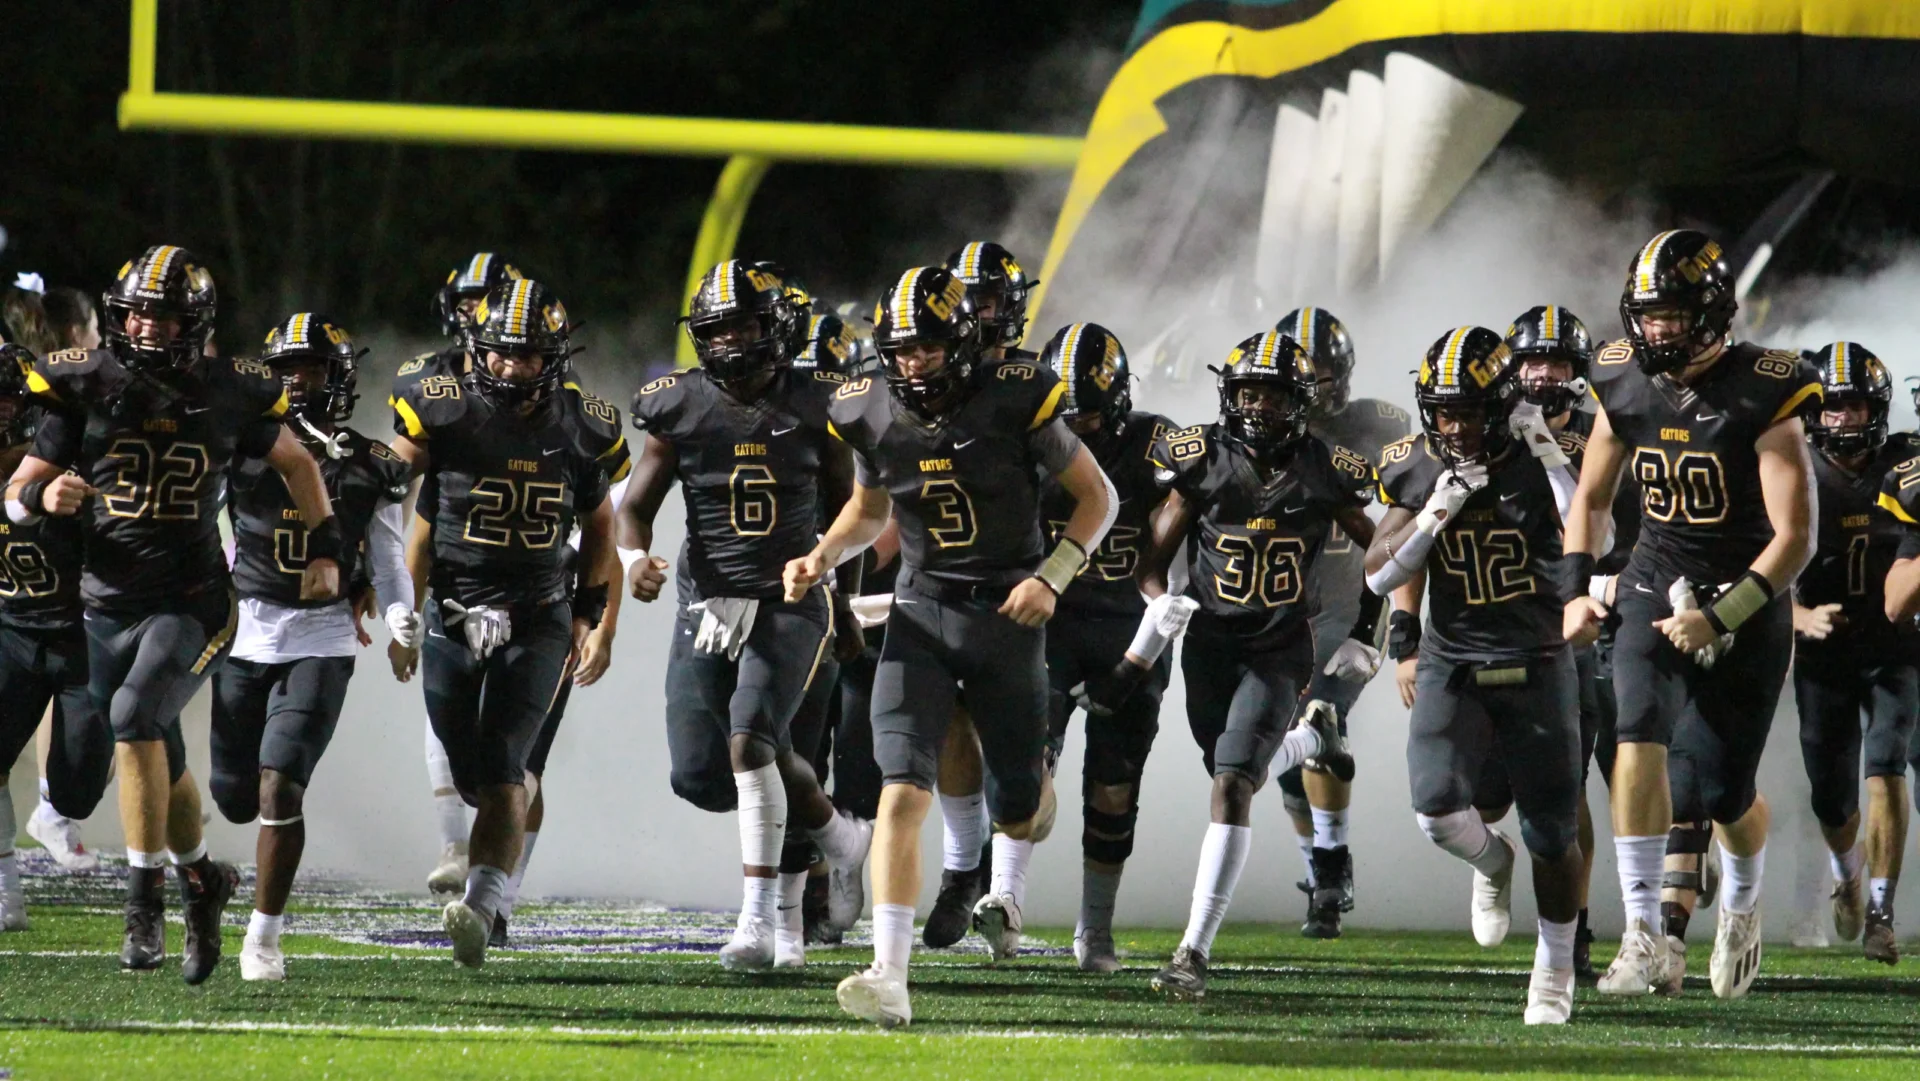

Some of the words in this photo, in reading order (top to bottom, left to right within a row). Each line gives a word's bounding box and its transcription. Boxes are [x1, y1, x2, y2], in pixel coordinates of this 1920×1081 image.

[711, 302, 737, 312] Riddell
[500, 335, 527, 344] Riddell
[1251, 366, 1279, 375] Riddell
[1434, 385, 1460, 395] Riddell
[1660, 427, 1690, 442] GATORS
[734, 443, 767, 456] GATORS
[507, 459, 538, 473] GATORS
[919, 458, 953, 472] GATORS
[102, 438, 210, 519] 32
[1631, 446, 1729, 523] 80
[729, 464, 777, 536] 6
[463, 476, 564, 549] 25
[920, 479, 978, 548] 3
[1246, 518, 1276, 530] GATORS
[1214, 533, 1306, 607] 38
[1435, 528, 1536, 605] 42
[1846, 533, 1870, 596] 1
